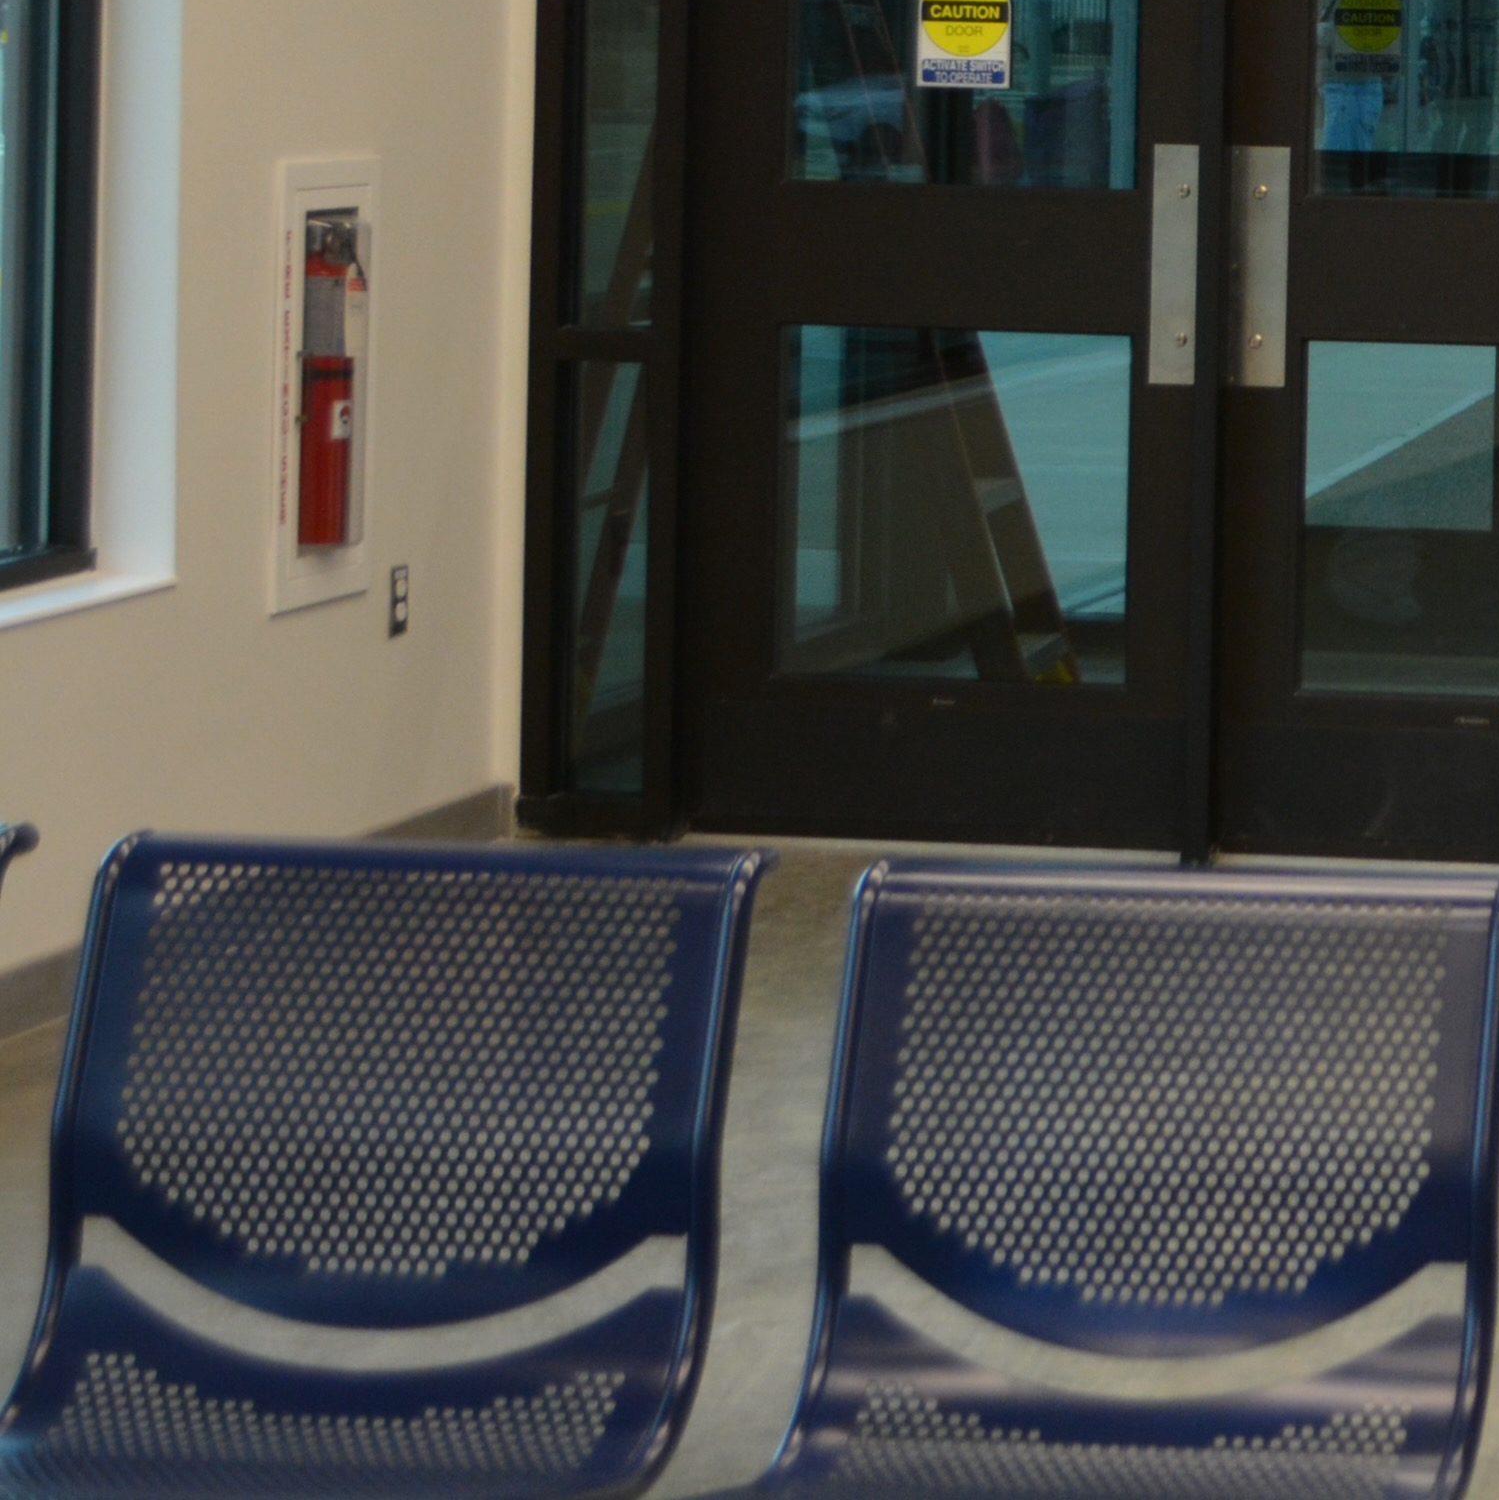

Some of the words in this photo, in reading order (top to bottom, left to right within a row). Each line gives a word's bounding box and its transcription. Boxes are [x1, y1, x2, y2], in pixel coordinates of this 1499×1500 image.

[930, 4, 1000, 19] CAUTION
[1342, 13, 1395, 23] CAUTION
[945, 25, 983, 36] DOOR
[923, 60, 968, 71] ACTIVATE
[969, 60, 1005, 72] SWITCH
[935, 71, 948, 83] TO
[950, 72, 992, 84] OPERATE
